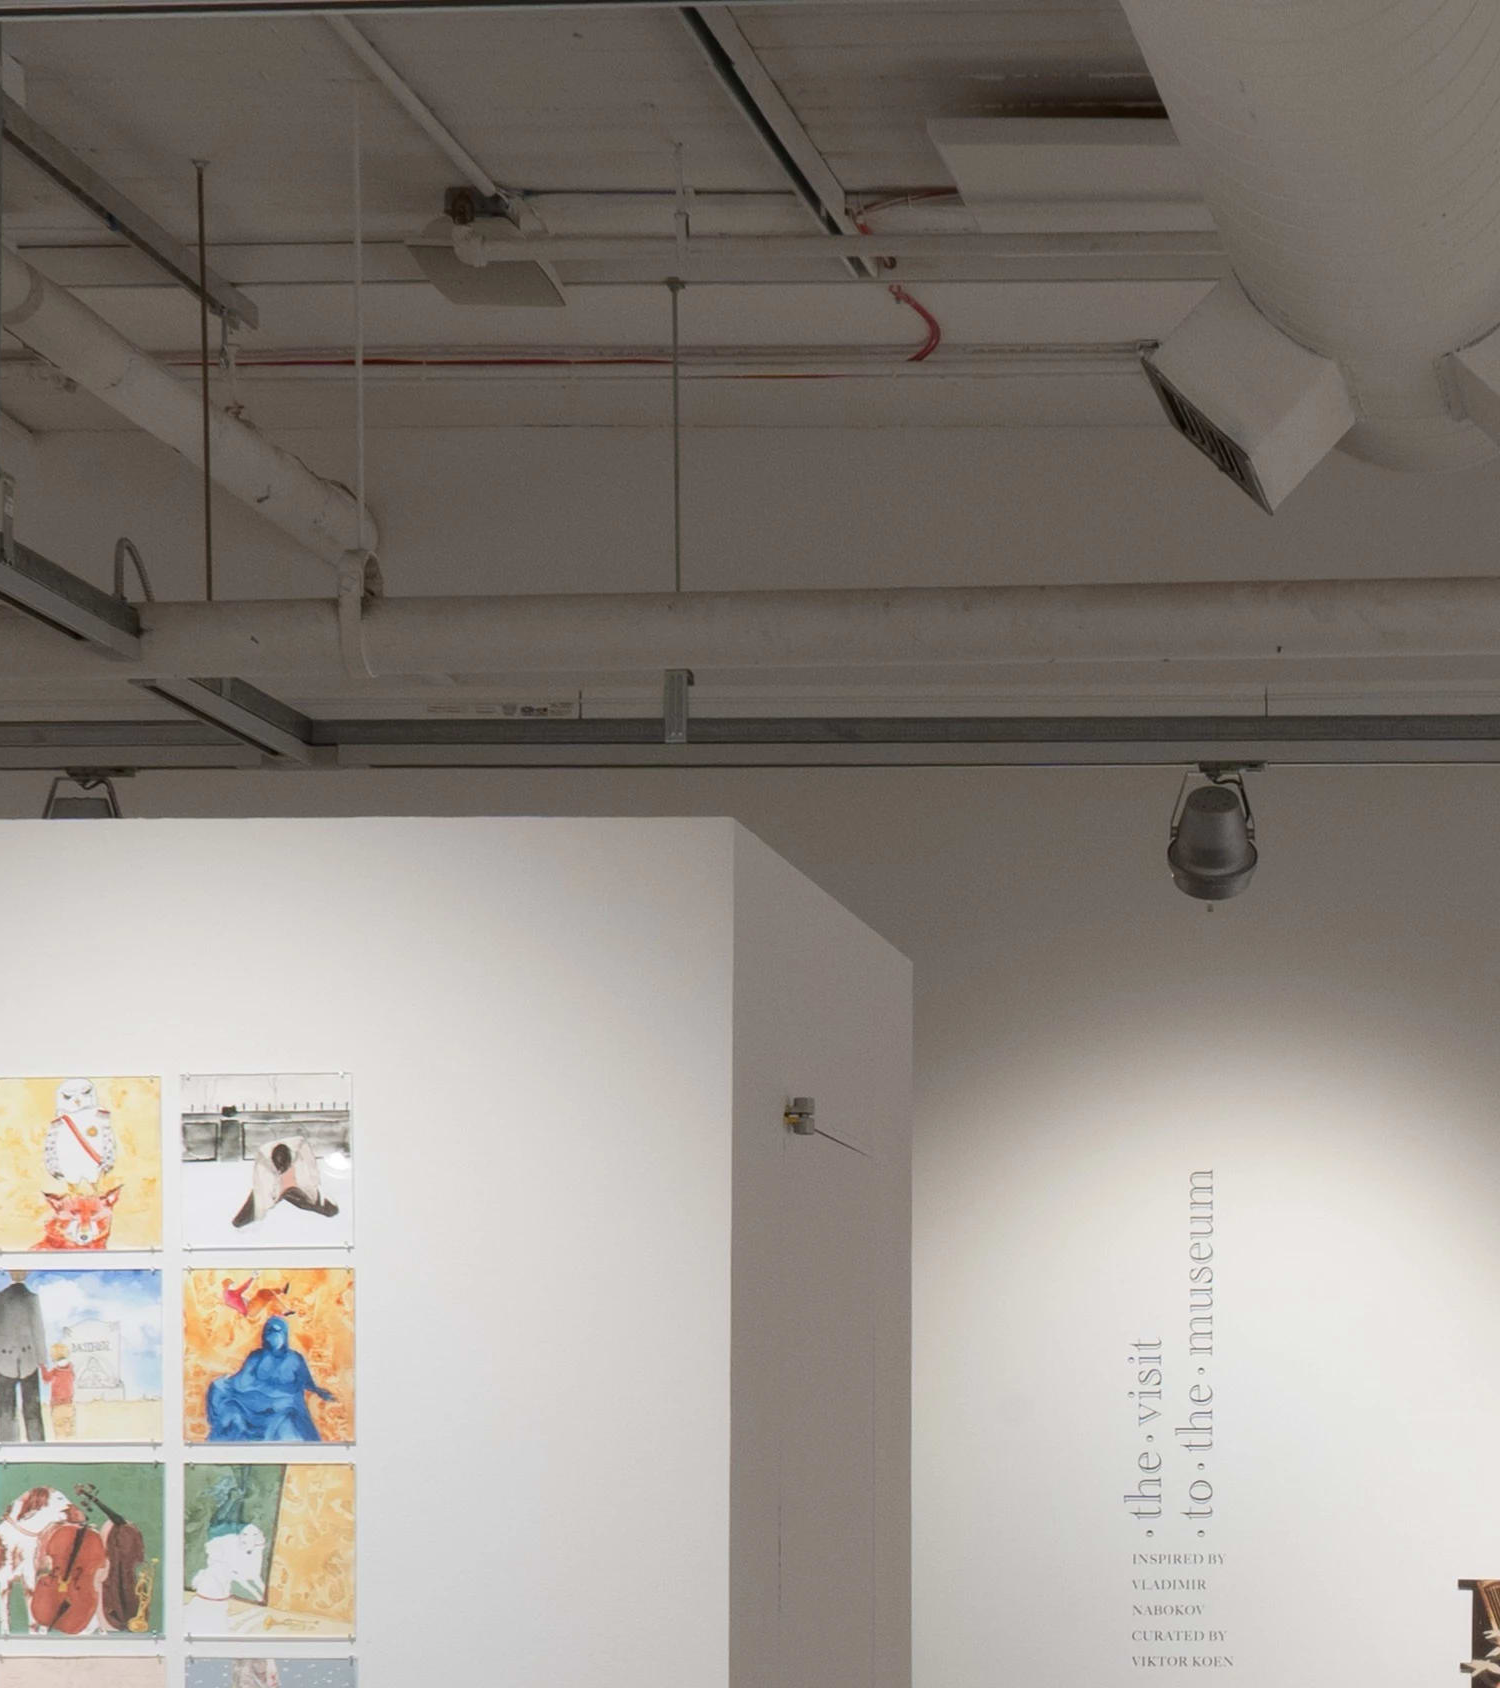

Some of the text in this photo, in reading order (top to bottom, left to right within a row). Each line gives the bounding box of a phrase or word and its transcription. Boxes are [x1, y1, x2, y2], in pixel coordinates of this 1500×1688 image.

[1174, 1168, 1213, 1520] to the museum
[1123, 1337, 1162, 1520] the visit
[1132, 1553, 1227, 1565] INSPIRED BY
[1131, 1579, 1206, 1591] VLADIMIR
[1132, 1604, 1205, 1616] NABOKOV
[1131, 1630, 1228, 1641] CURATED BY
[1131, 1656, 1234, 1667] VIKTOR KOEN
